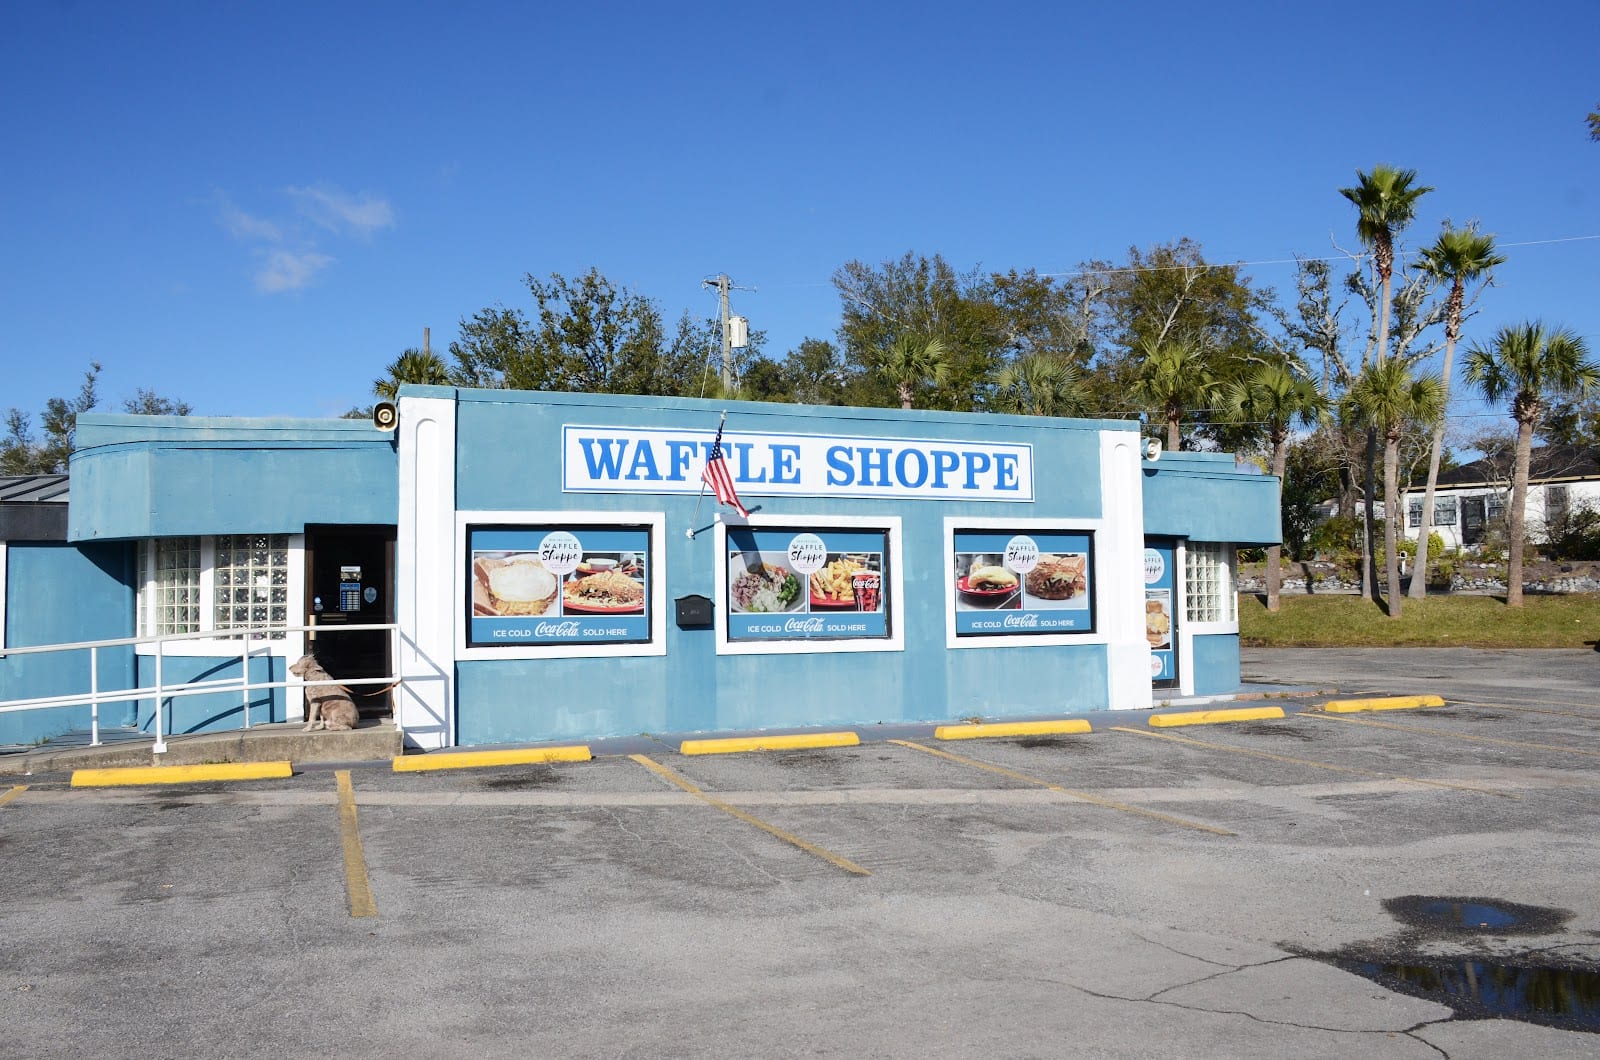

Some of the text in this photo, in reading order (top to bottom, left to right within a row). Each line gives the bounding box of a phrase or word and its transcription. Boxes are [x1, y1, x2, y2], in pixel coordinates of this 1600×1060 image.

[578, 437, 1019, 491] WAFLE SHOPPE
[747, 625, 760, 633] ICE
[761, 624, 782, 632] COLD
[972, 621, 982, 629] ICE
[983, 620, 1001, 628] COLD
[1058, 619, 1075, 627] HERE
[493, 629, 506, 637] ICE
[508, 629, 531, 637] COLD
[583, 628, 604, 636] SOLD
[606, 628, 628, 636] HERE
